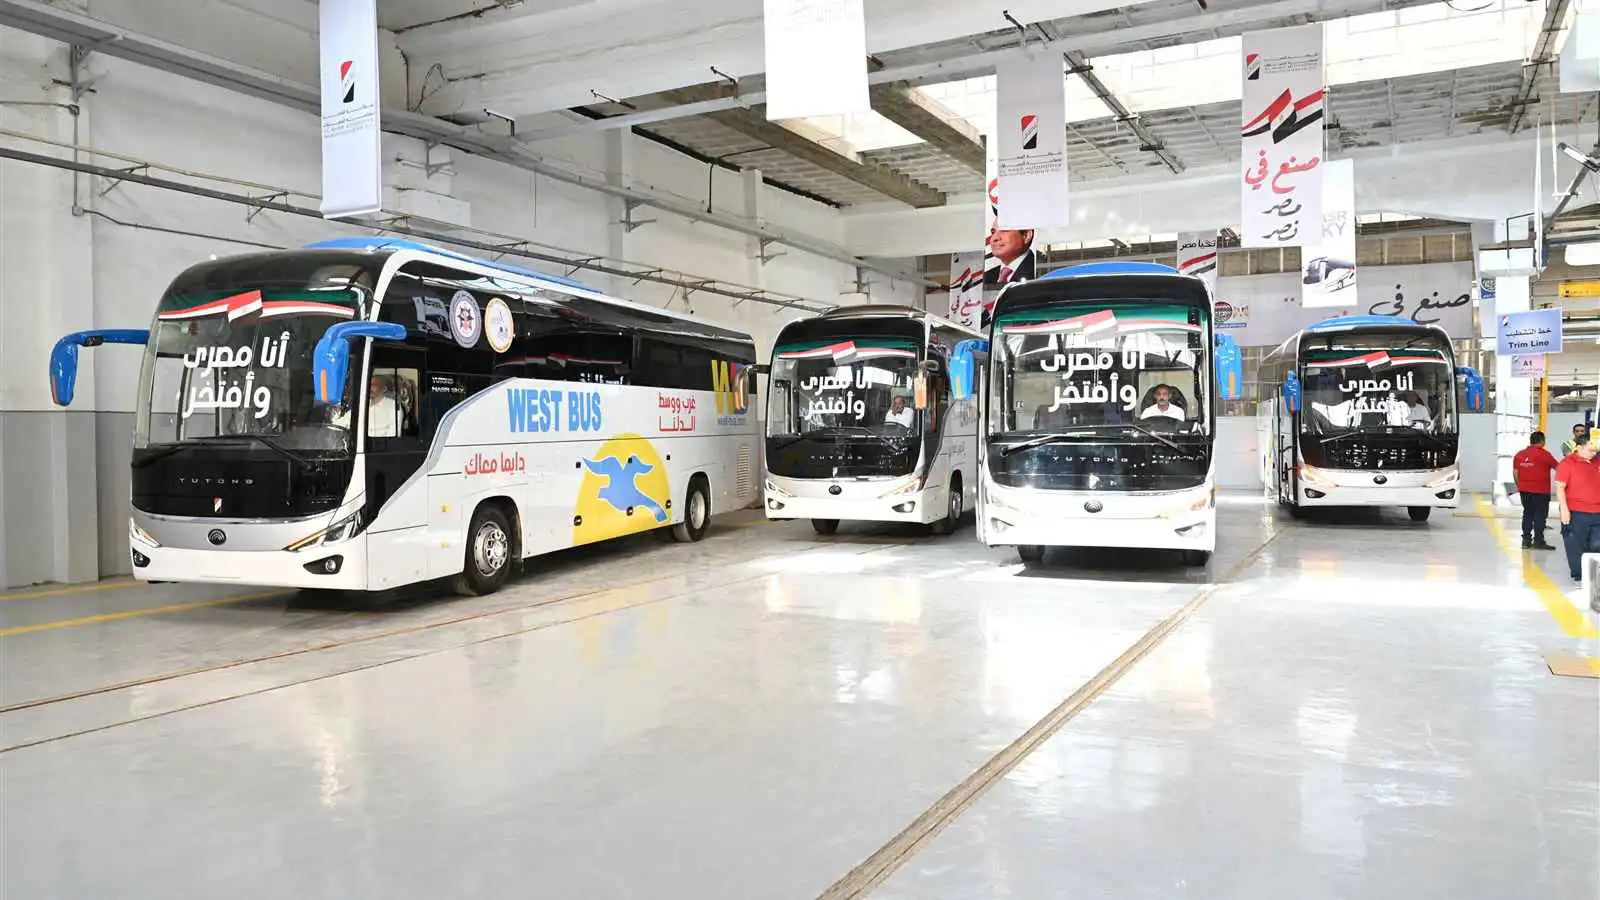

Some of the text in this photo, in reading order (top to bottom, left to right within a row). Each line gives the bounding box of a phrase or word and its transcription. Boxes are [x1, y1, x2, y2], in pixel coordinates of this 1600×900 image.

[1244, 150, 1321, 194] صنع في
[1262, 197, 1303, 217] مصر
[1179, 241, 1198, 251] مصر
[1411, 290, 1471, 325] صنع
[261, 330, 291, 368] أنا
[181, 370, 271, 419] وأفتخر
[1048, 372, 1137, 412] وأفتخر
[1396, 370, 1413, 391] أنا
[507, 388, 602, 433] WEST BUS
[464, 452, 498, 477] معاك
